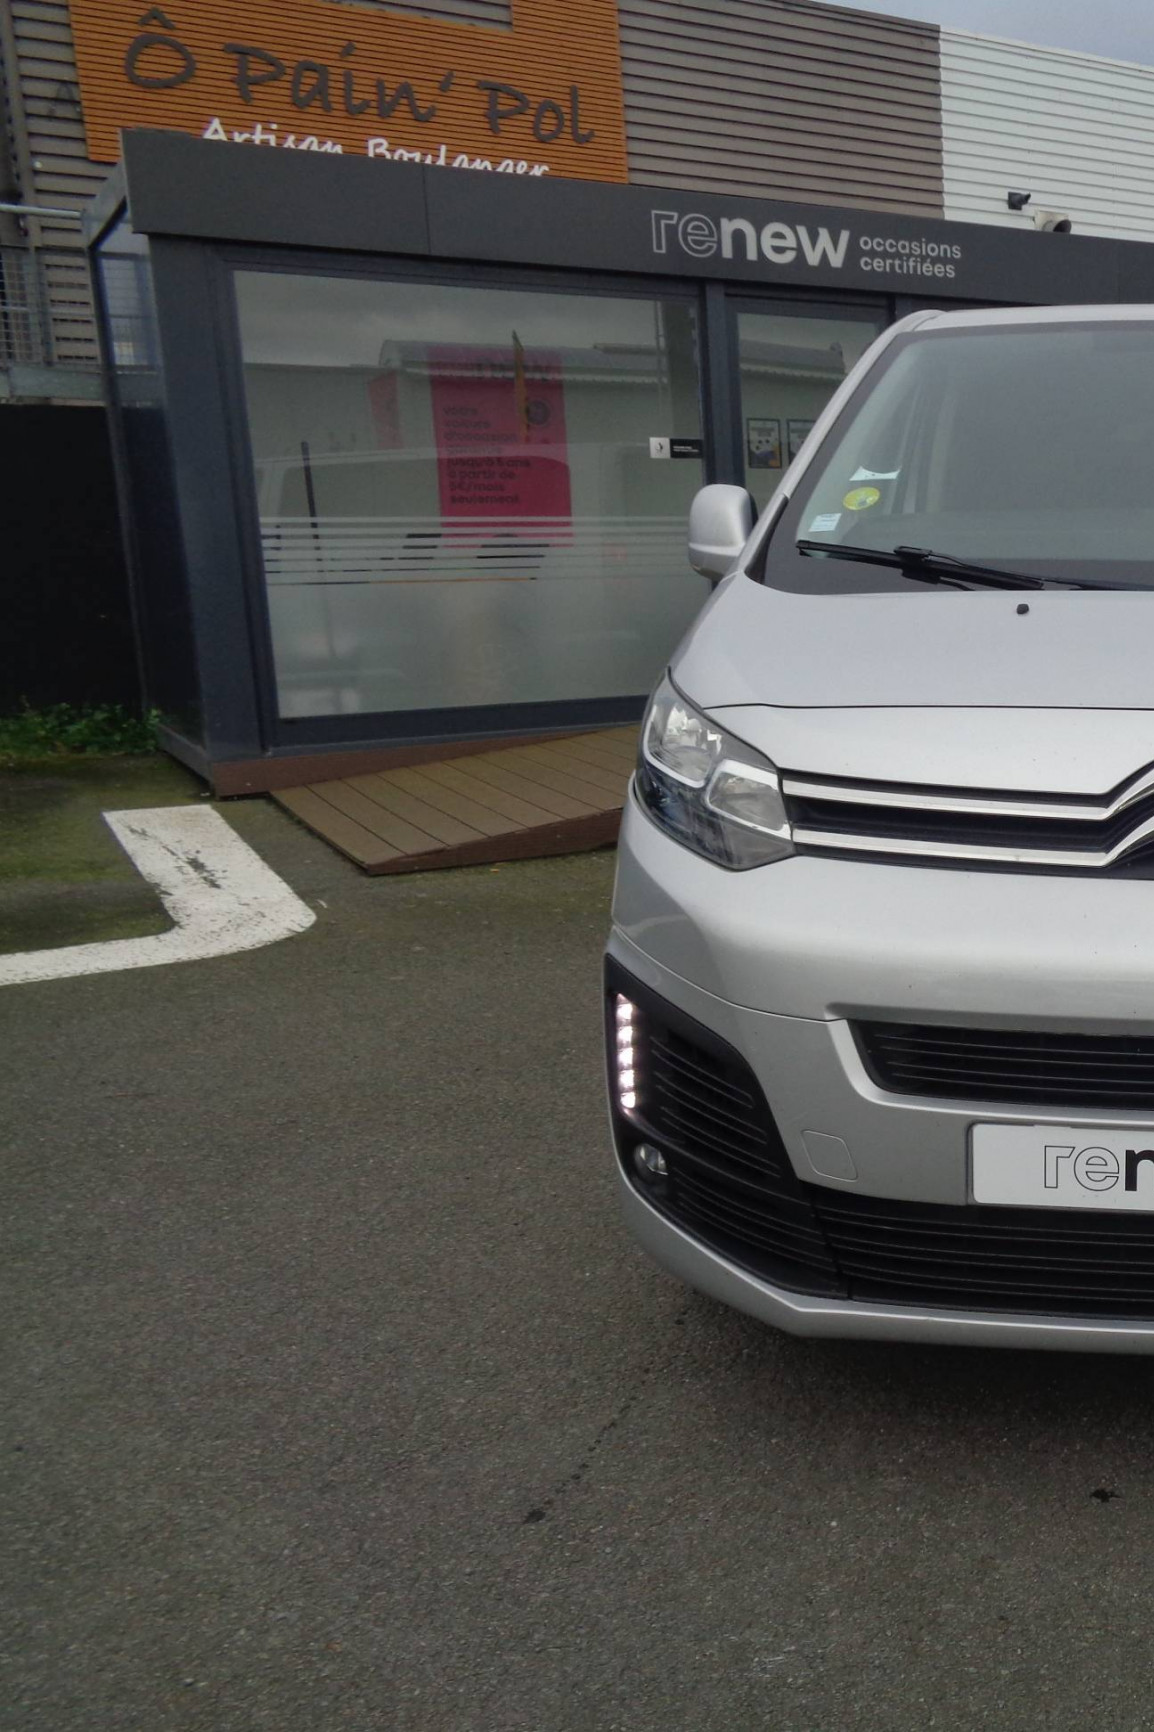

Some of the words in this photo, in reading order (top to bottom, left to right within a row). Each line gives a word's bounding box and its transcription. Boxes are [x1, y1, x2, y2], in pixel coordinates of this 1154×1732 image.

[125, 7, 196, 89] Ô
[478, 80, 594, 145] Pol
[651, 209, 850, 268] renew
[859, 235, 962, 259] occasions
[859, 255, 957, 278] certifiées
